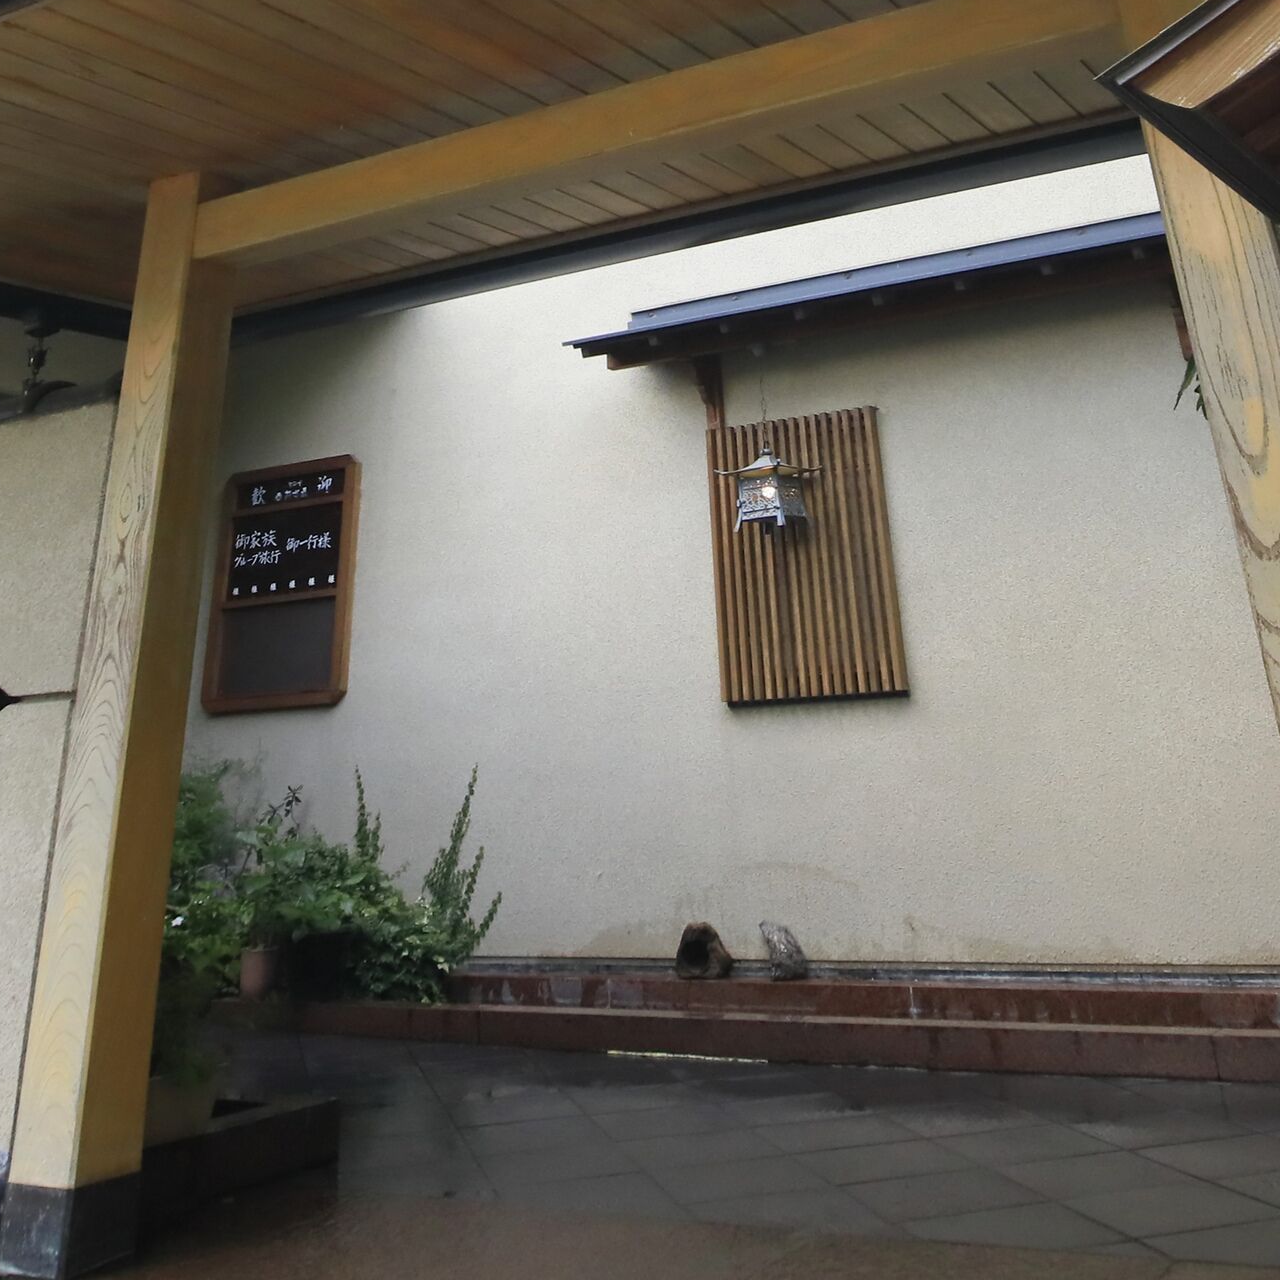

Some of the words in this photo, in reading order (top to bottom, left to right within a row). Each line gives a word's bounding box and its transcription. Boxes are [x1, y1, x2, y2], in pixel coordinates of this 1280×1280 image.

[235, 530, 278, 550] 御家族
[234, 549, 282, 568] グループ旅行
